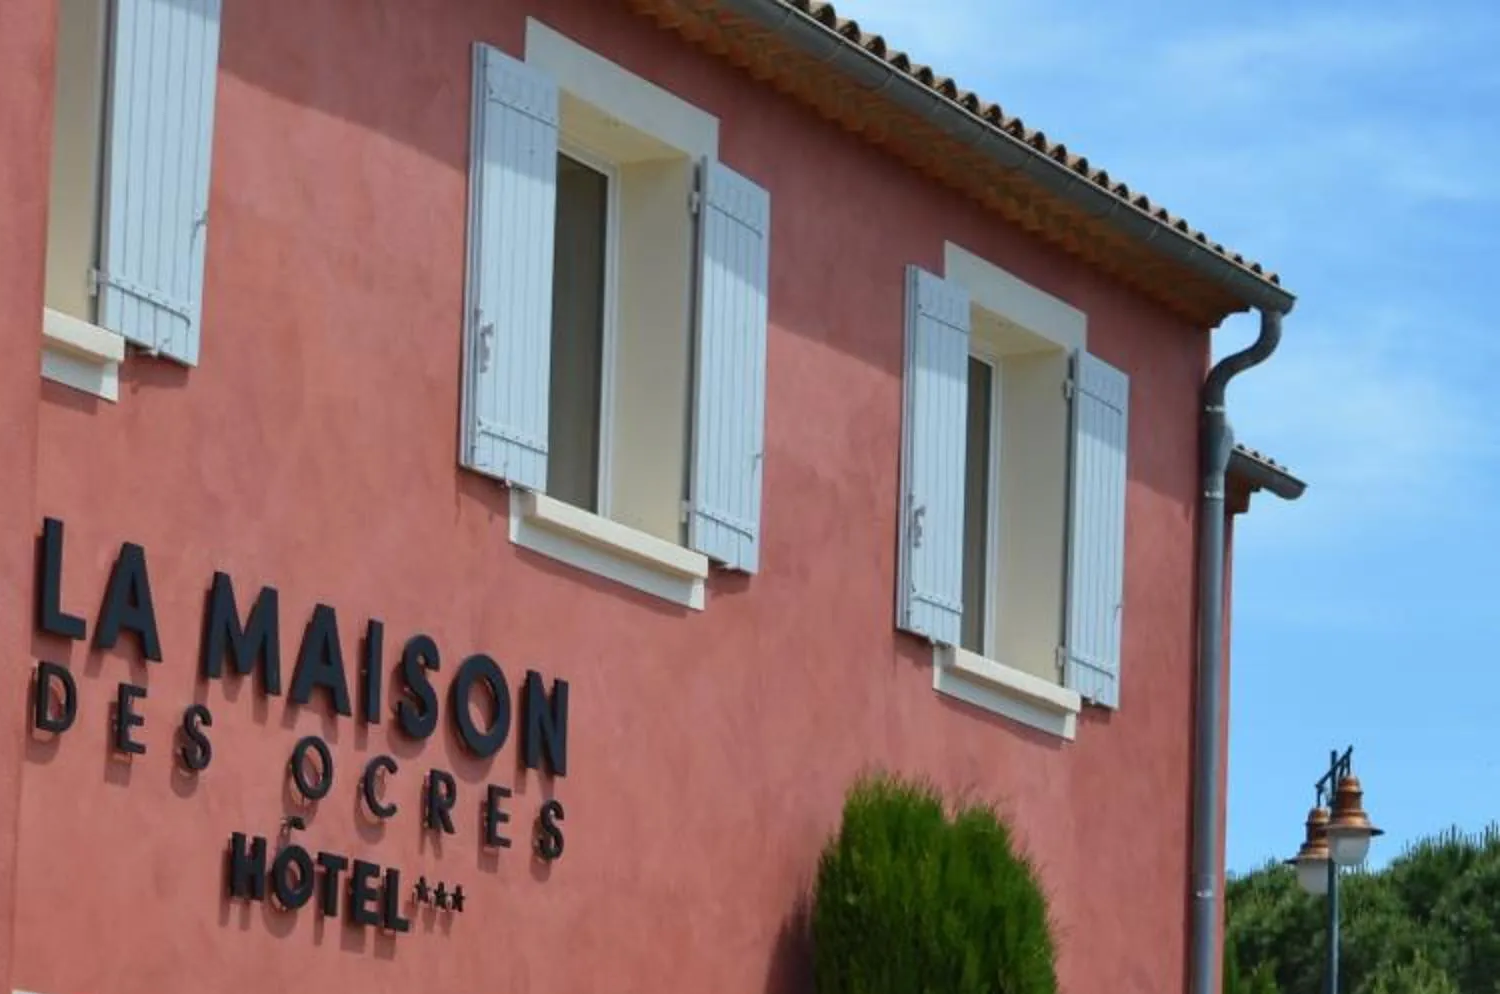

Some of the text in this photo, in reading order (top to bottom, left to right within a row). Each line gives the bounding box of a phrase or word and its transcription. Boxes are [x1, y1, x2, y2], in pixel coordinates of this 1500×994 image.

[32, 660, 565, 861] DES OCRES
[36, 517, 568, 776] LA MAISON
